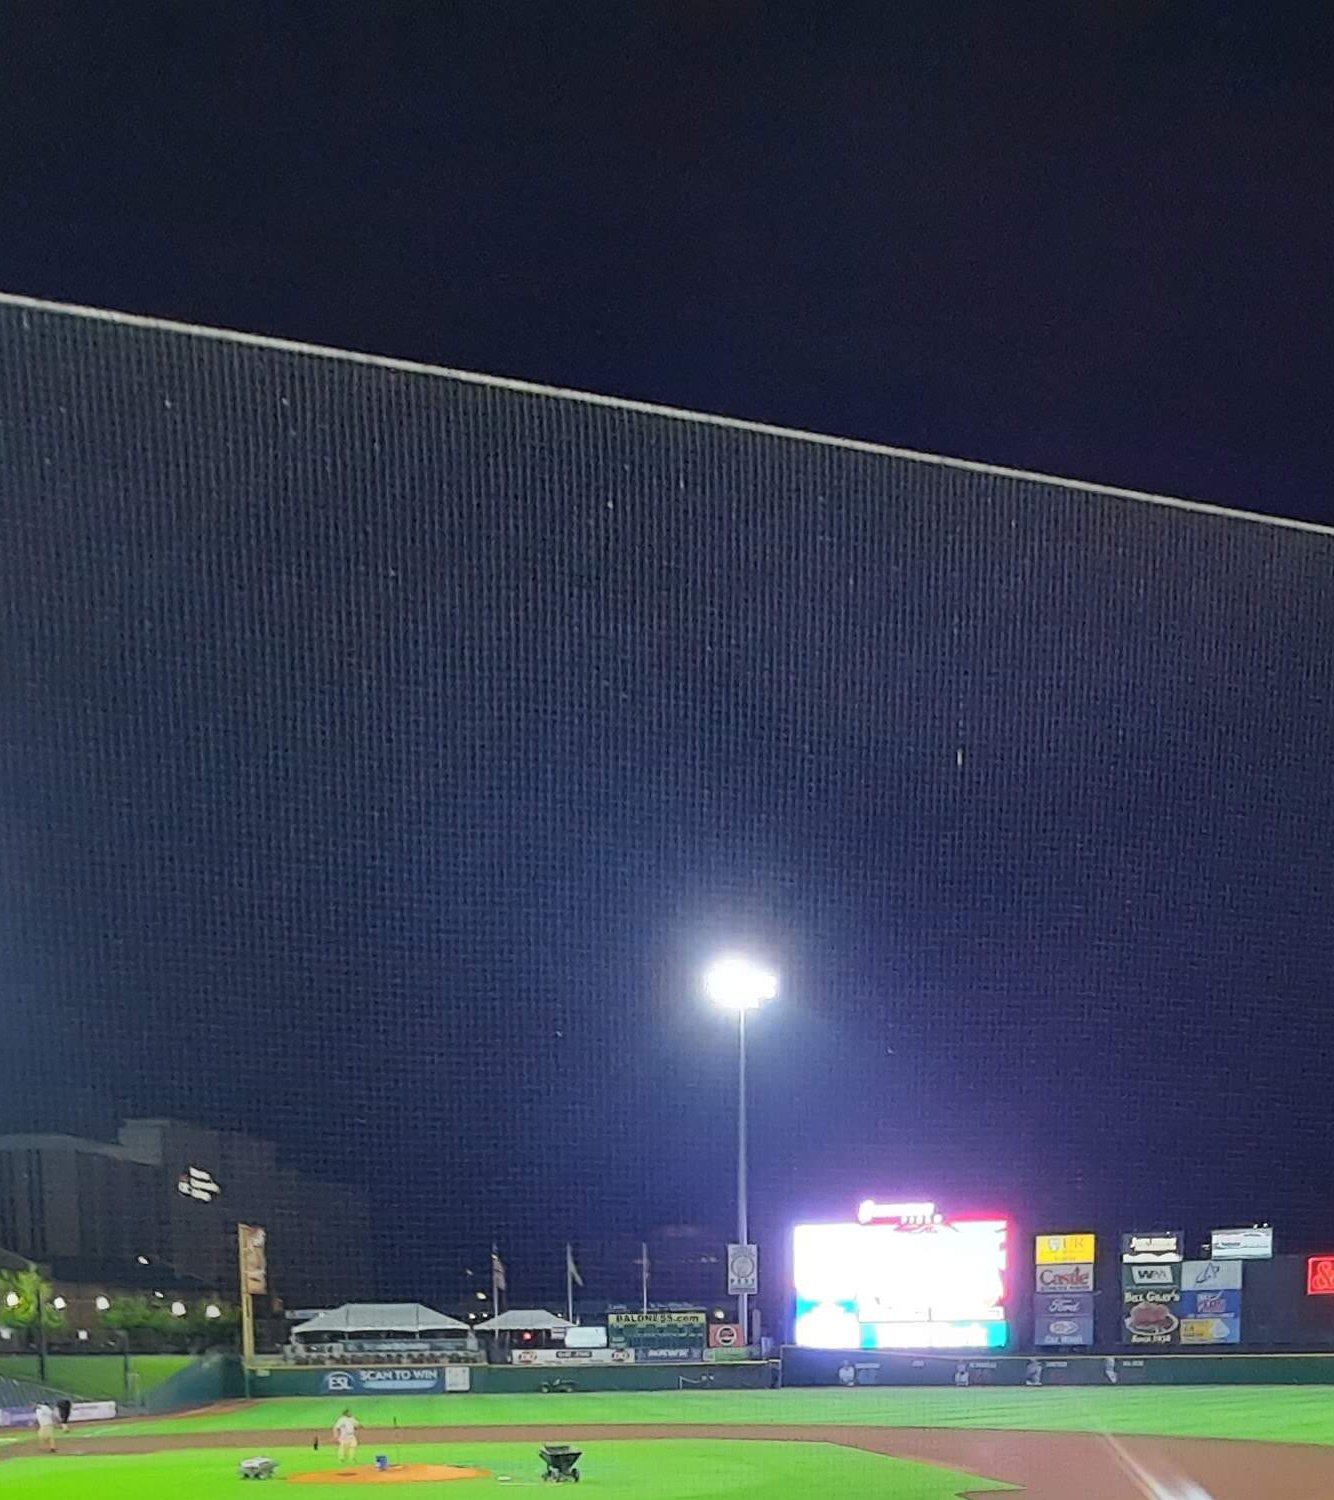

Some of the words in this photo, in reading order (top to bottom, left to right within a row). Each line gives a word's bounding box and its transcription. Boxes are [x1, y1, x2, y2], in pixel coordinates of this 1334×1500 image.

[360, 1369, 393, 1381] SCAN
[395, 1370, 411, 1380] TO
[412, 1369, 437, 1380] WIN
[328, 1377, 354, 1390] ESL
